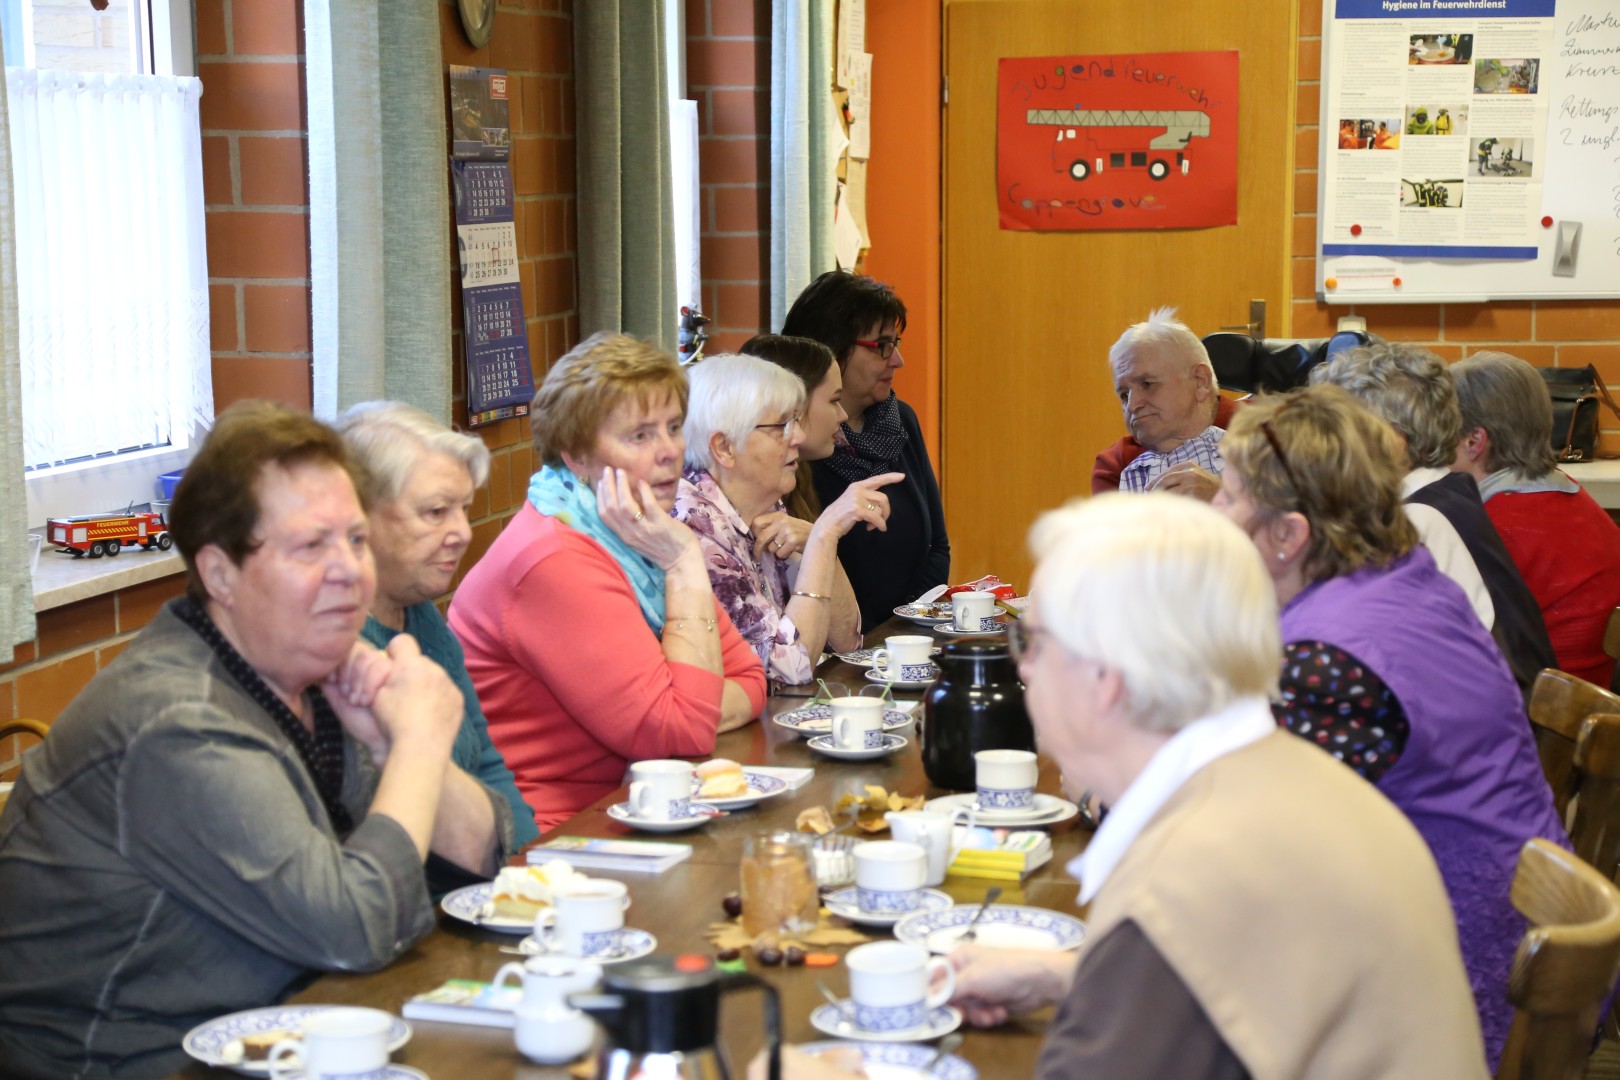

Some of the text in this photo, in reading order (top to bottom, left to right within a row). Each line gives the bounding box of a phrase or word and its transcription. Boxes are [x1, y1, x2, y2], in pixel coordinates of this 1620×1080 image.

[1382, 0, 1506, 11] Hygiene im Feuerwehrdienst
[96, 520, 130, 528] FEUERWEHR
